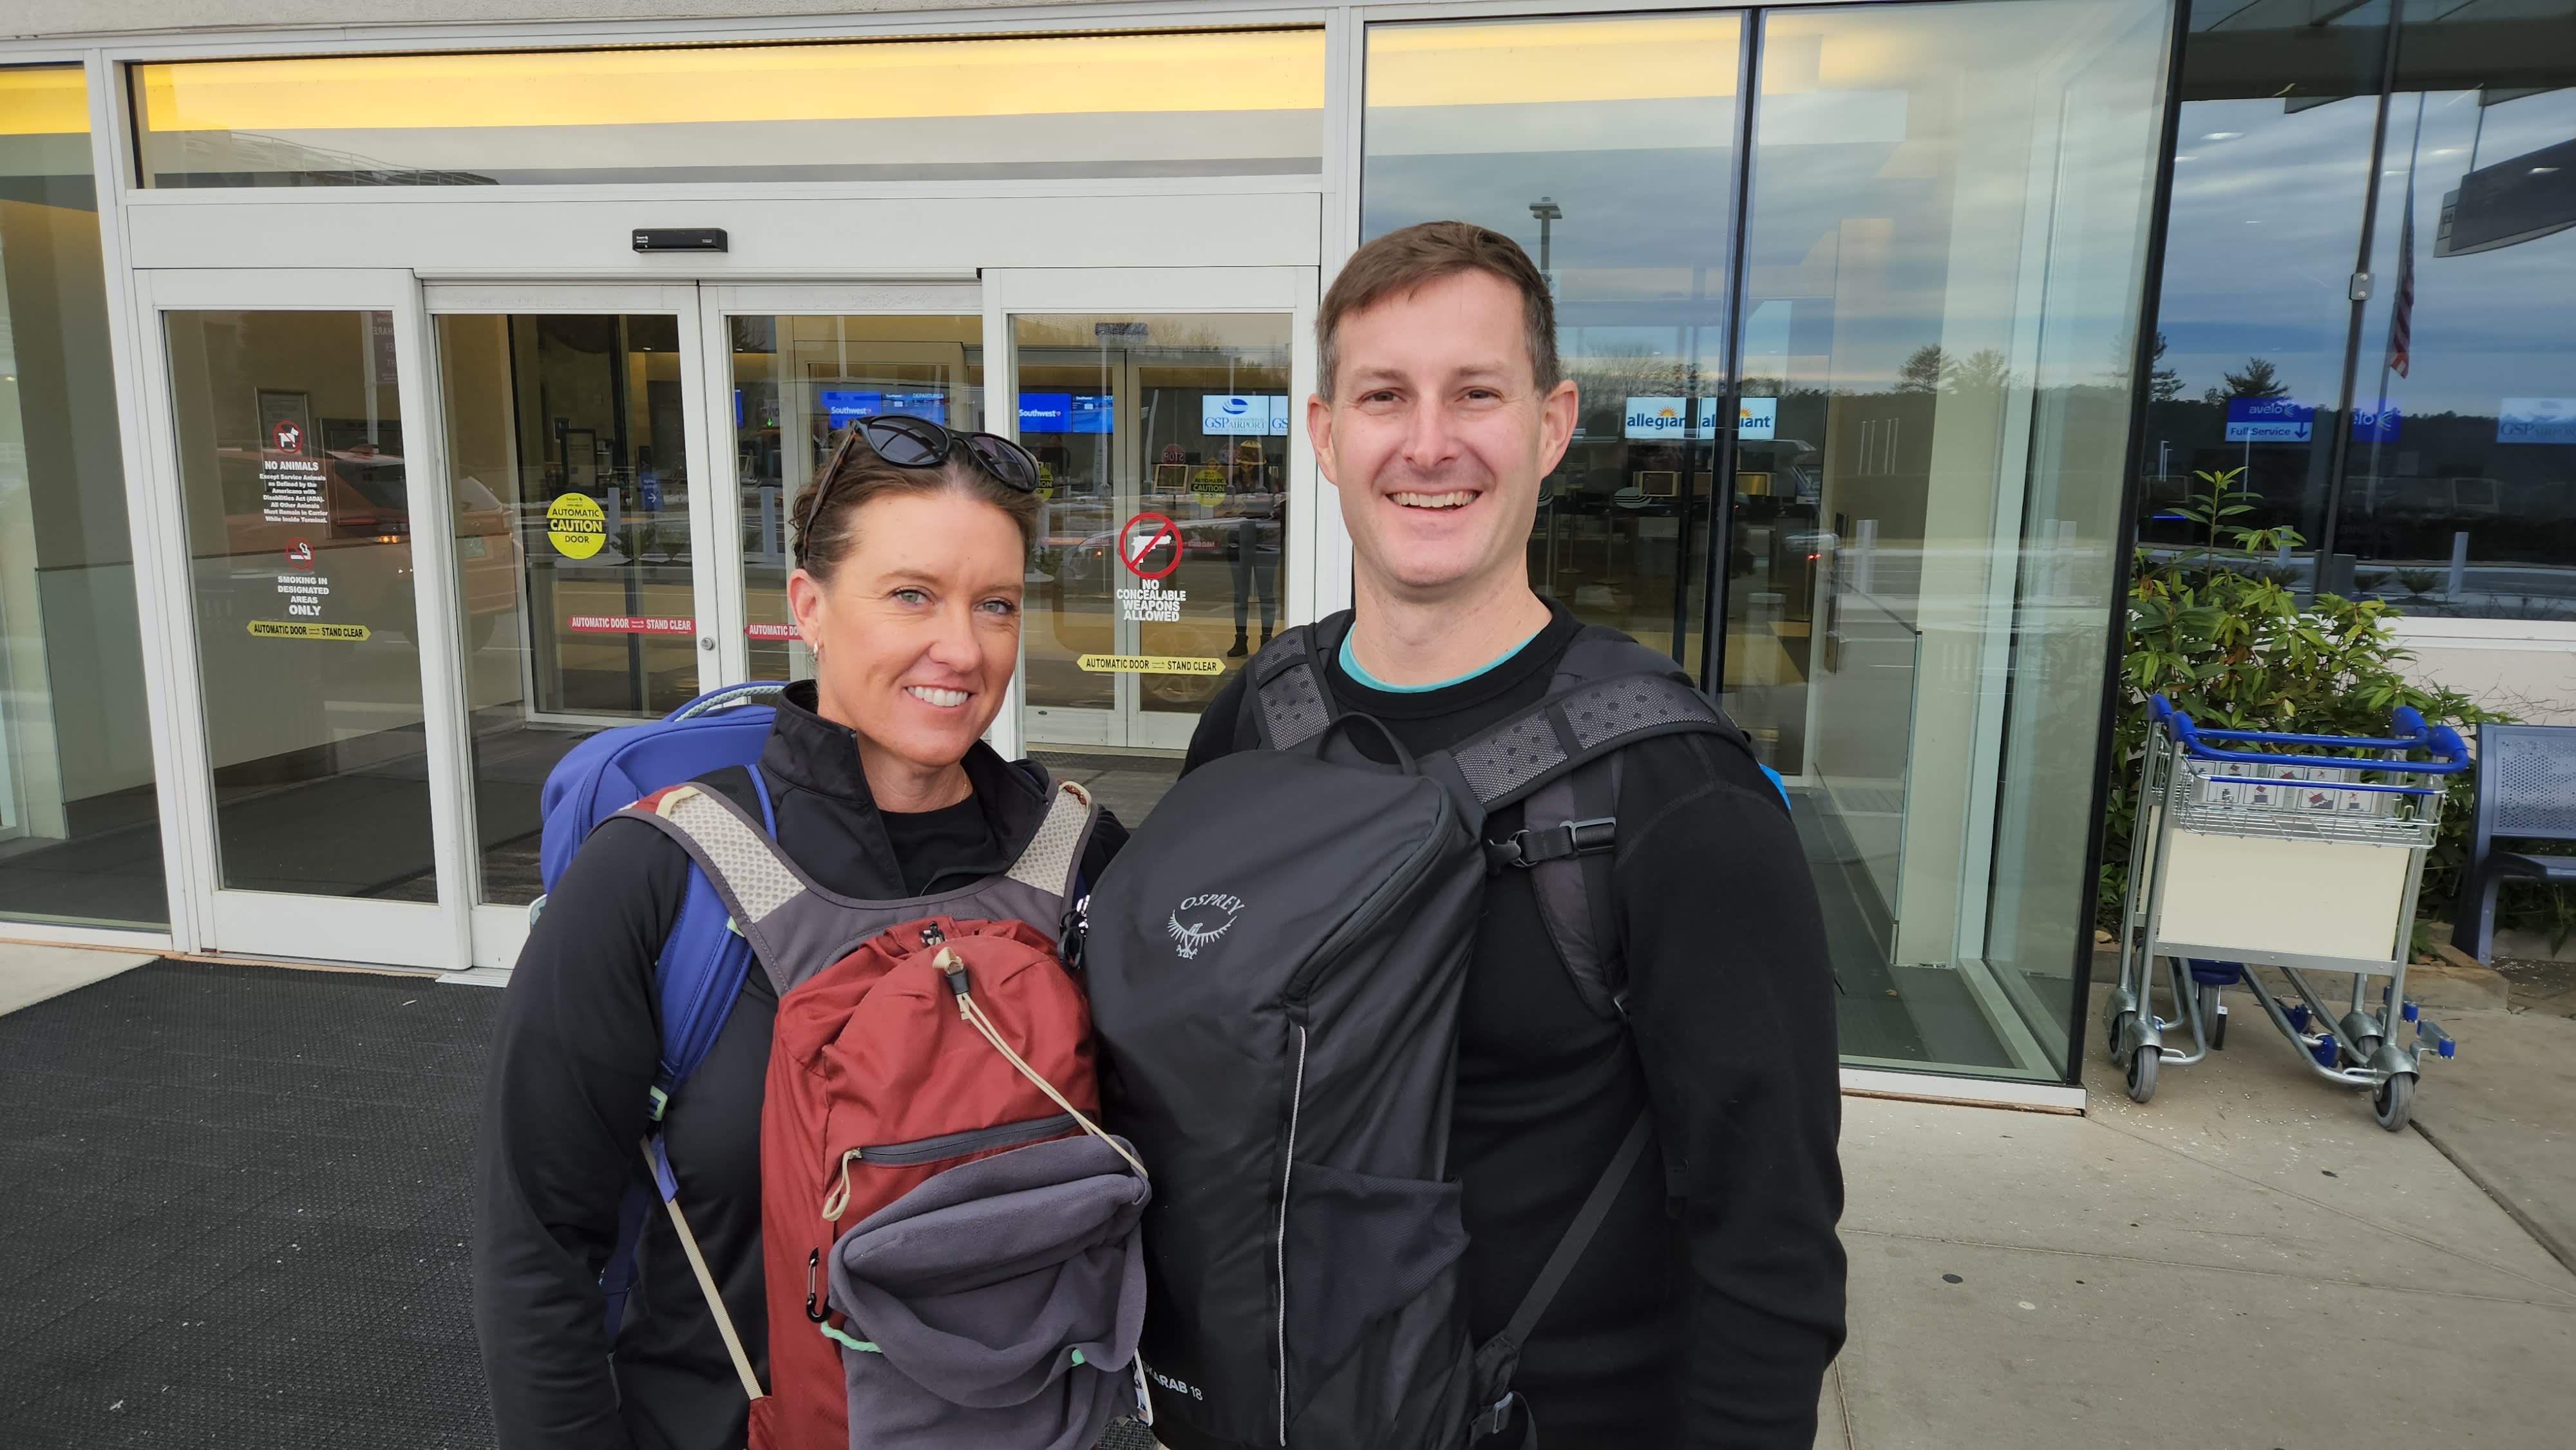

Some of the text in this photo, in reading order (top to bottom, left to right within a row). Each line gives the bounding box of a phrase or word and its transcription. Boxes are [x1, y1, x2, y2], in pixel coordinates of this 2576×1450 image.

[831, 406, 867, 415] Southwest
[1019, 409, 1056, 417] Southwest
[2249, 404, 2282, 414] avelo
[1205, 417, 1229, 428] GSP
[1272, 417, 1288, 429] GS
[2230, 427, 2291, 436] Full Service
[265, 461, 319, 471] NO ANIMALS
[552, 508, 600, 517] AUTOMATIC
[550, 519, 603, 532] CAUTION
[565, 535, 589, 543] DOOR
[278, 576, 317, 585] SMOKING
[1142, 579, 1159, 590] NO
[278, 585, 330, 595] DESIGNATED
[1116, 588, 1186, 601] CONCEALABLE
[290, 596, 318, 604] AREAS
[1122, 599, 1180, 612] WEAPONS
[289, 605, 321, 616] ONLY
[1123, 610, 1180, 622] ALLOWED
[572, 617, 609, 628] AUTOMATIC
[611, 618, 629, 628] DOOR
[646, 620, 668, 629] STAND
[670, 619, 691, 630] CLEAR
[254, 624, 289, 634] AUTOMATIC
[290, 625, 307, 635] DOOR
[321, 627, 342, 636] STAND
[343, 628, 363, 637] CLEAR
[749, 625, 788, 636] AUTOMATIC
[1086, 658, 1128, 669] AUTOMATIC
[1129, 659, 1150, 670] DOOR
[1167, 661, 1191, 671] STAND
[1193, 661, 1217, 672] CLEAR
[1180, 894, 1245, 916] OSPREY
[1190, 1386, 1203, 1401] 18
